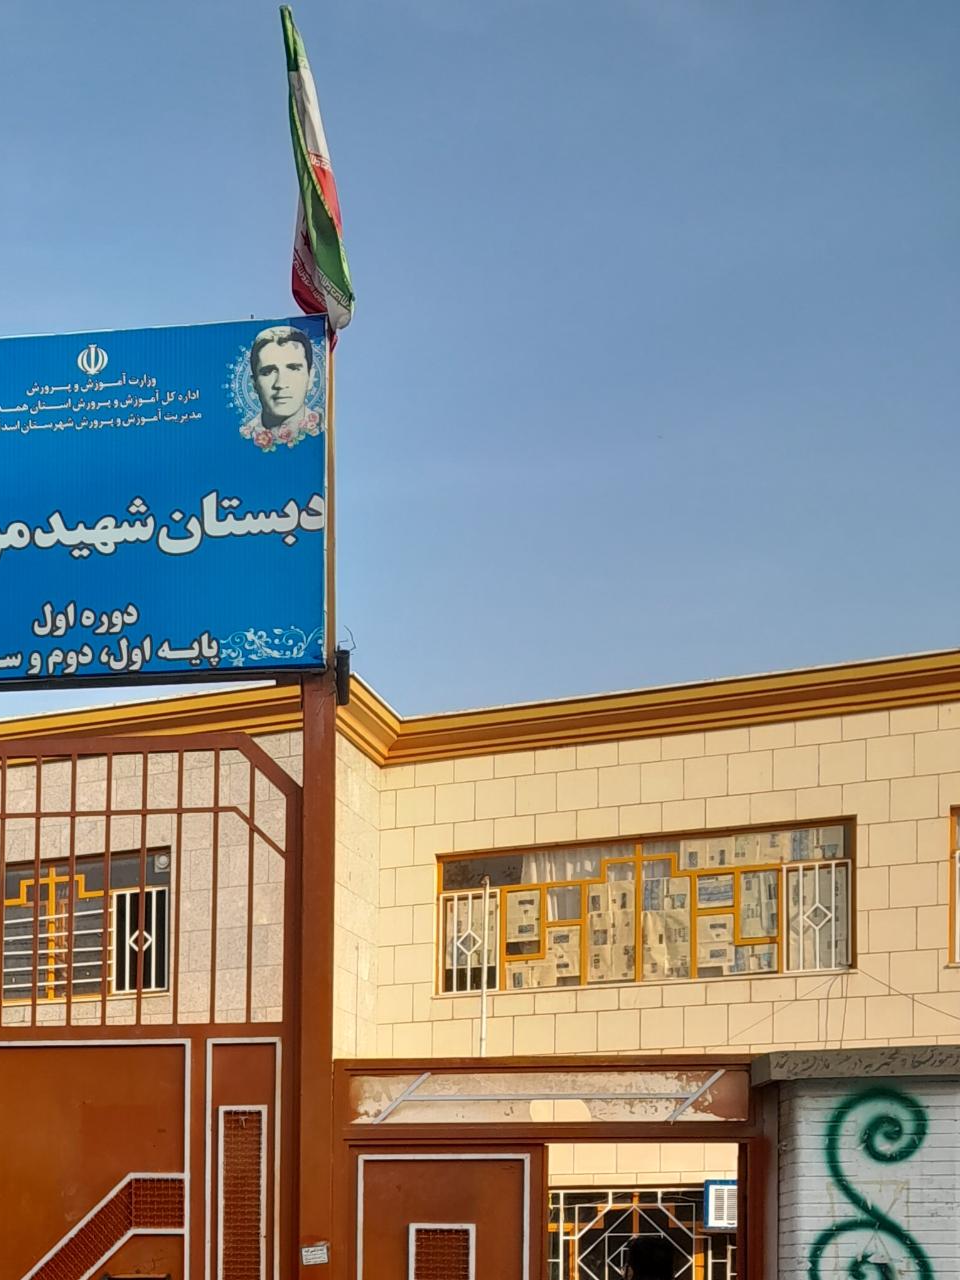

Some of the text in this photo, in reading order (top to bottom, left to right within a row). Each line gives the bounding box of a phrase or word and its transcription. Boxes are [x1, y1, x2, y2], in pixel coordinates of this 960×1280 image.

[26, 381, 71, 396] پرورش
[80, 372, 126, 392] آموزش
[128, 373, 157, 387] وزارت
[72, 397, 111, 411] پرورش
[120, 390, 159, 409] آموزش
[161, 391, 176, 406] کل
[177, 389, 200, 404] اداره
[30, 398, 71, 414] استان
[20, 416, 74, 434] شهرستان
[75, 416, 114, 430] پرورش
[122, 408, 162, 427] آموزش
[163, 410, 202, 424] مدیریت
[33, 495, 156, 557] شهید
[157, 489, 325, 555] دبستان
[32, 600, 139, 637] دوره اول
[157, 631, 220, 669] پایه
[27, 652, 42, 675] و
[47, 643, 93, 676] دوم
